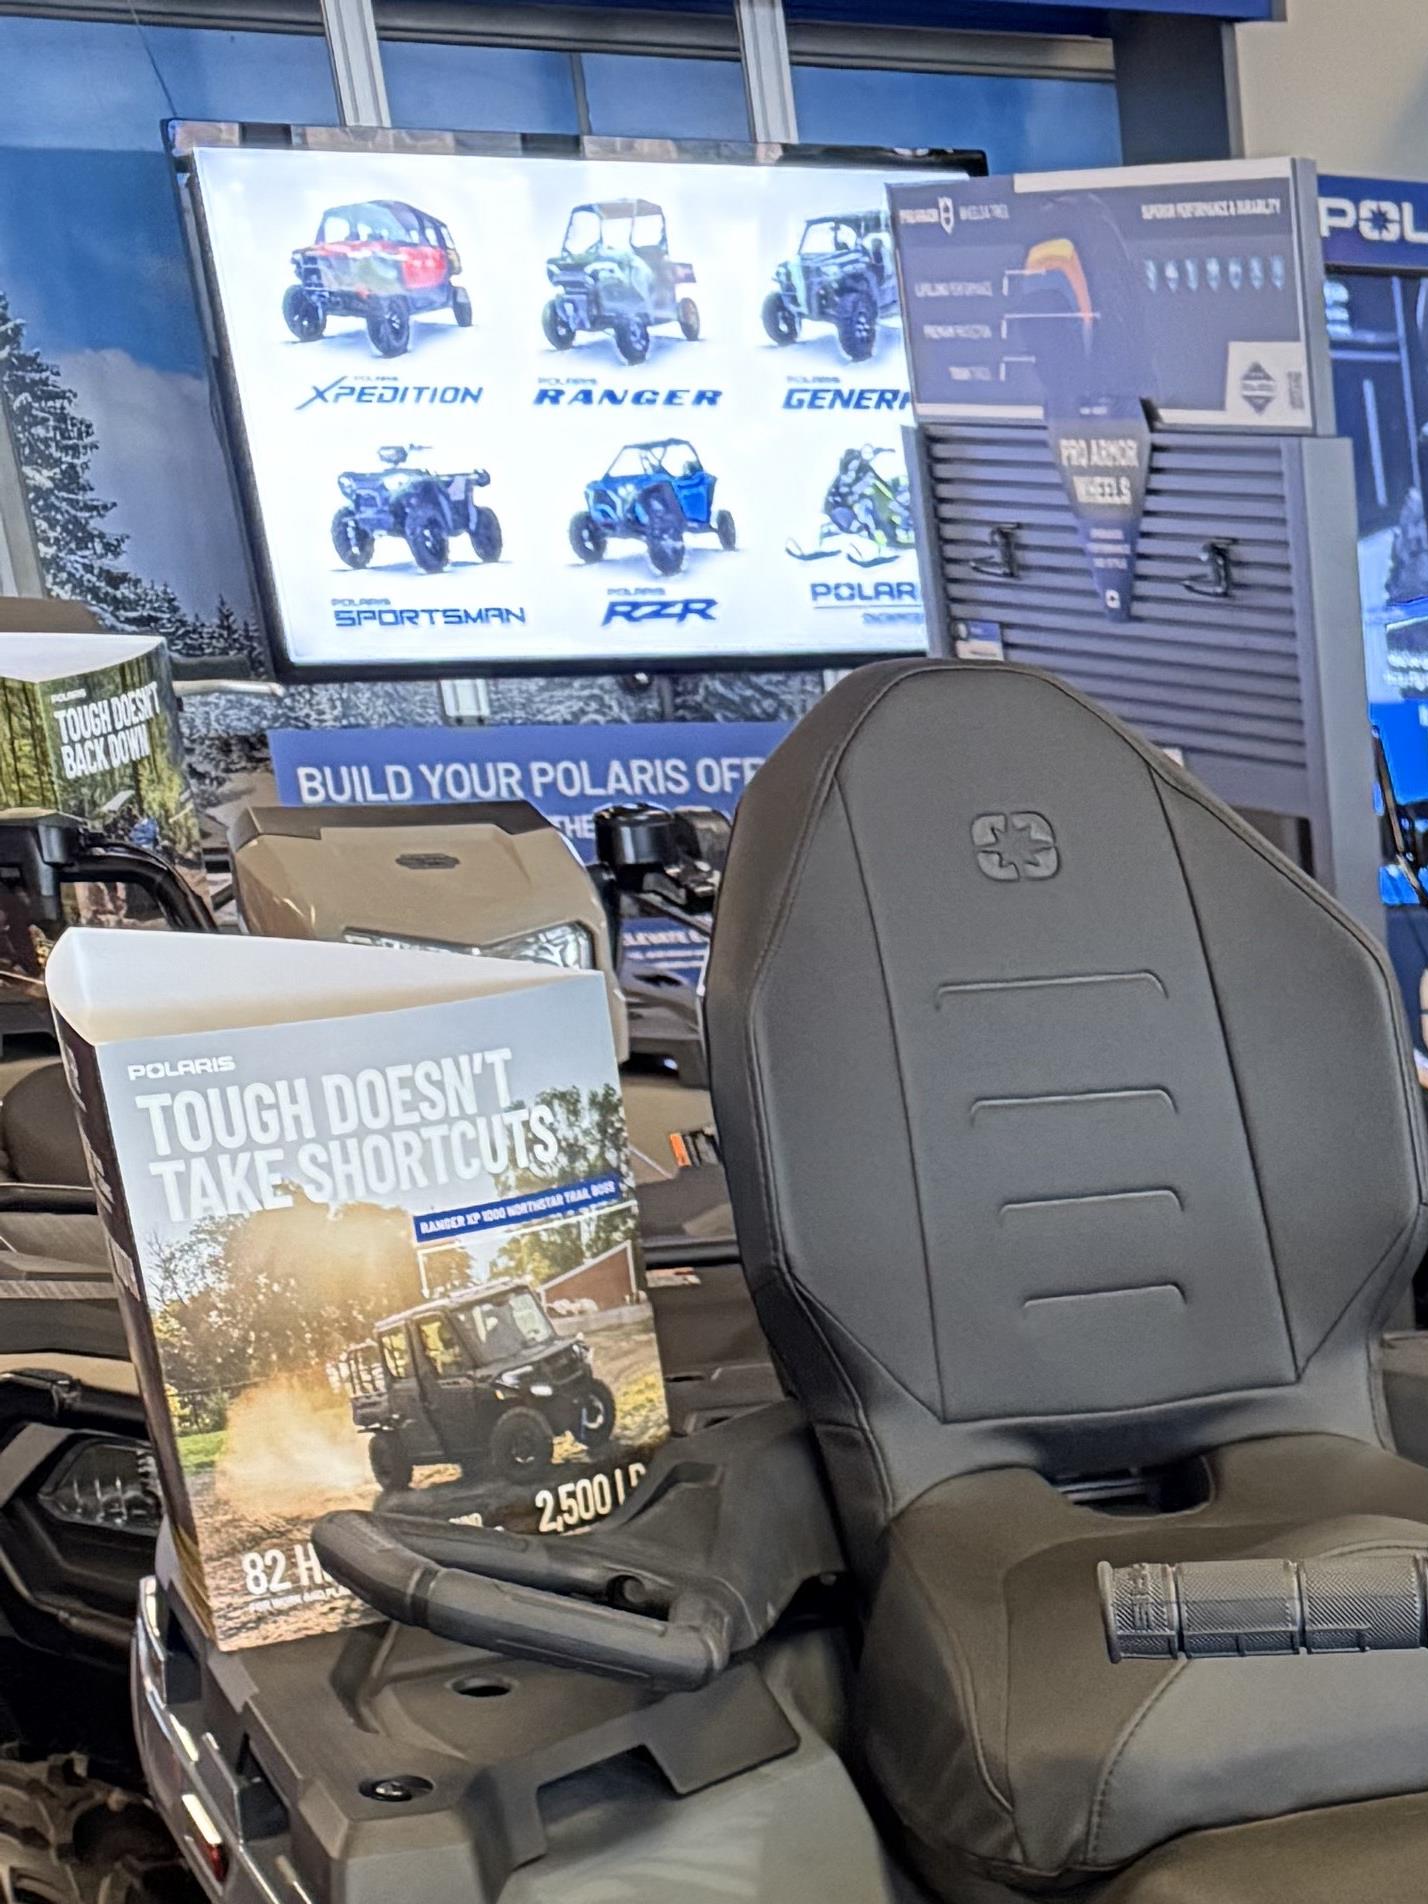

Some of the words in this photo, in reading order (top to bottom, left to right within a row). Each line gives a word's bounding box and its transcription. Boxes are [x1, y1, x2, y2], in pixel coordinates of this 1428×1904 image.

[295, 376, 483, 410] XPEDITION
[533, 388, 722, 406] RANGER
[334, 607, 526, 627] SPORTSMAN
[601, 599, 718, 626] RZR
[54, 699, 113, 744] TOUGH
[61, 737, 110, 780] BACK
[107, 724, 150, 769] DOWN
[297, 765, 413, 802] BUILD
[419, 762, 524, 800] YOUR
[531, 758, 690, 797] POLARIS
[128, 1056, 236, 1080] POLARIS
[135, 1078, 317, 1156] TOUGH
[321, 1047, 512, 1136] DOESN'T
[149, 1149, 294, 1222] TAKE
[296, 1104, 559, 1204] SHORTCUTS
[535, 1473, 612, 1534] 2,500
[241, 1549, 288, 1596] 82
